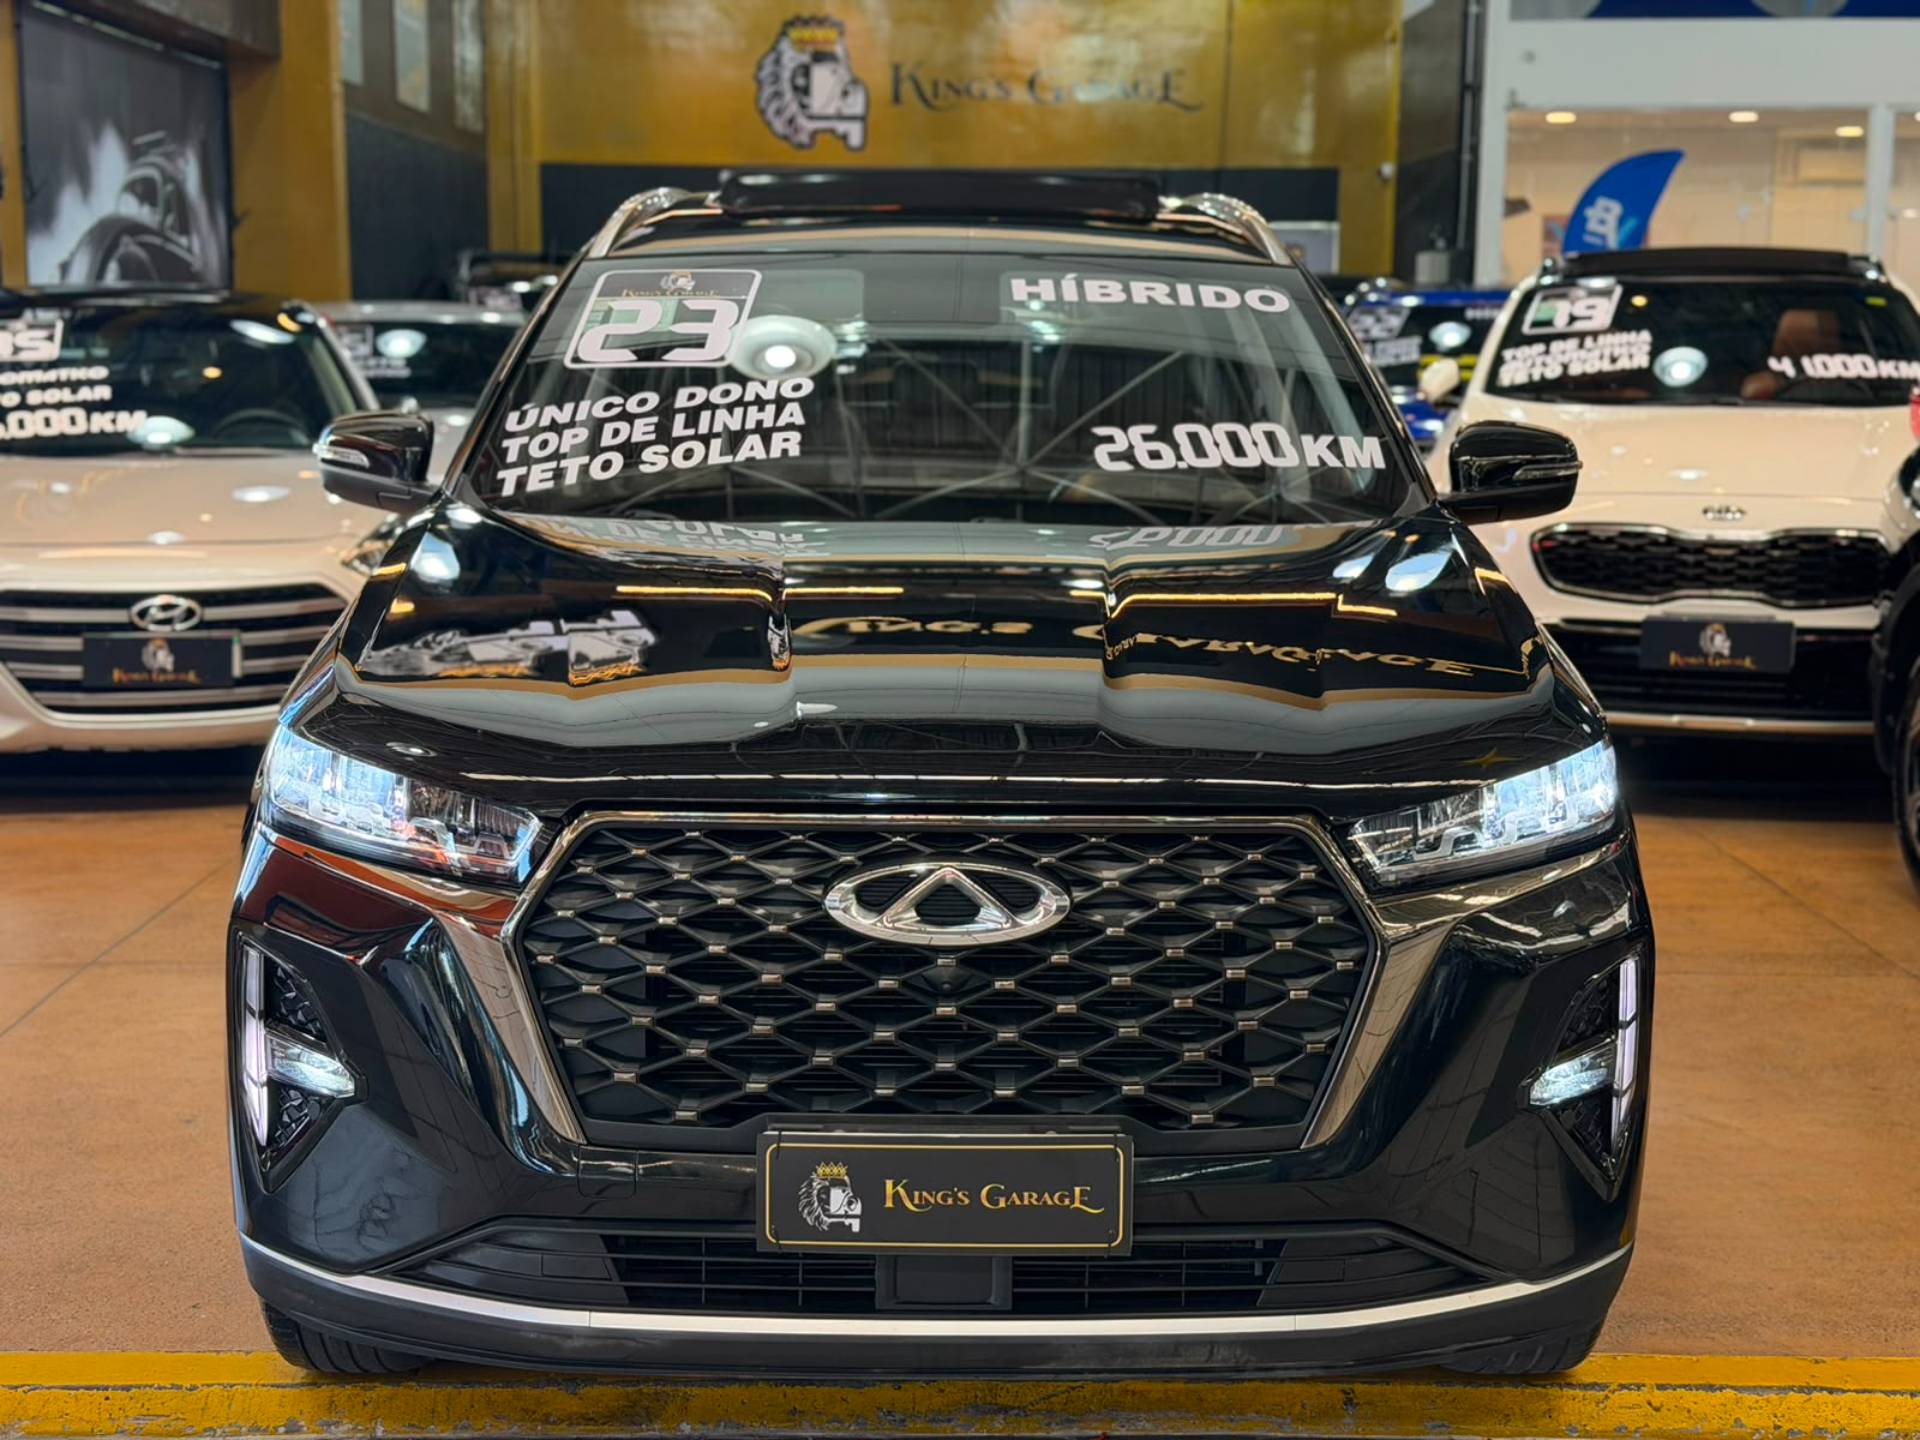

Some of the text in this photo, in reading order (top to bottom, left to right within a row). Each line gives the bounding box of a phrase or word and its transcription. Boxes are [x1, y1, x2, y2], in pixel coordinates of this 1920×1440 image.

[1011, 274, 1290, 312] HÍBRIDO
[577, 299, 740, 362] 23
[26, 384, 112, 406] SOLAR
[505, 377, 815, 433] ÚNICO DONO
[502, 401, 806, 463] TOP DE LINHA
[497, 430, 802, 499] TETO SOLAR
[884, 1178, 1104, 1215] KING'S GARAGE
